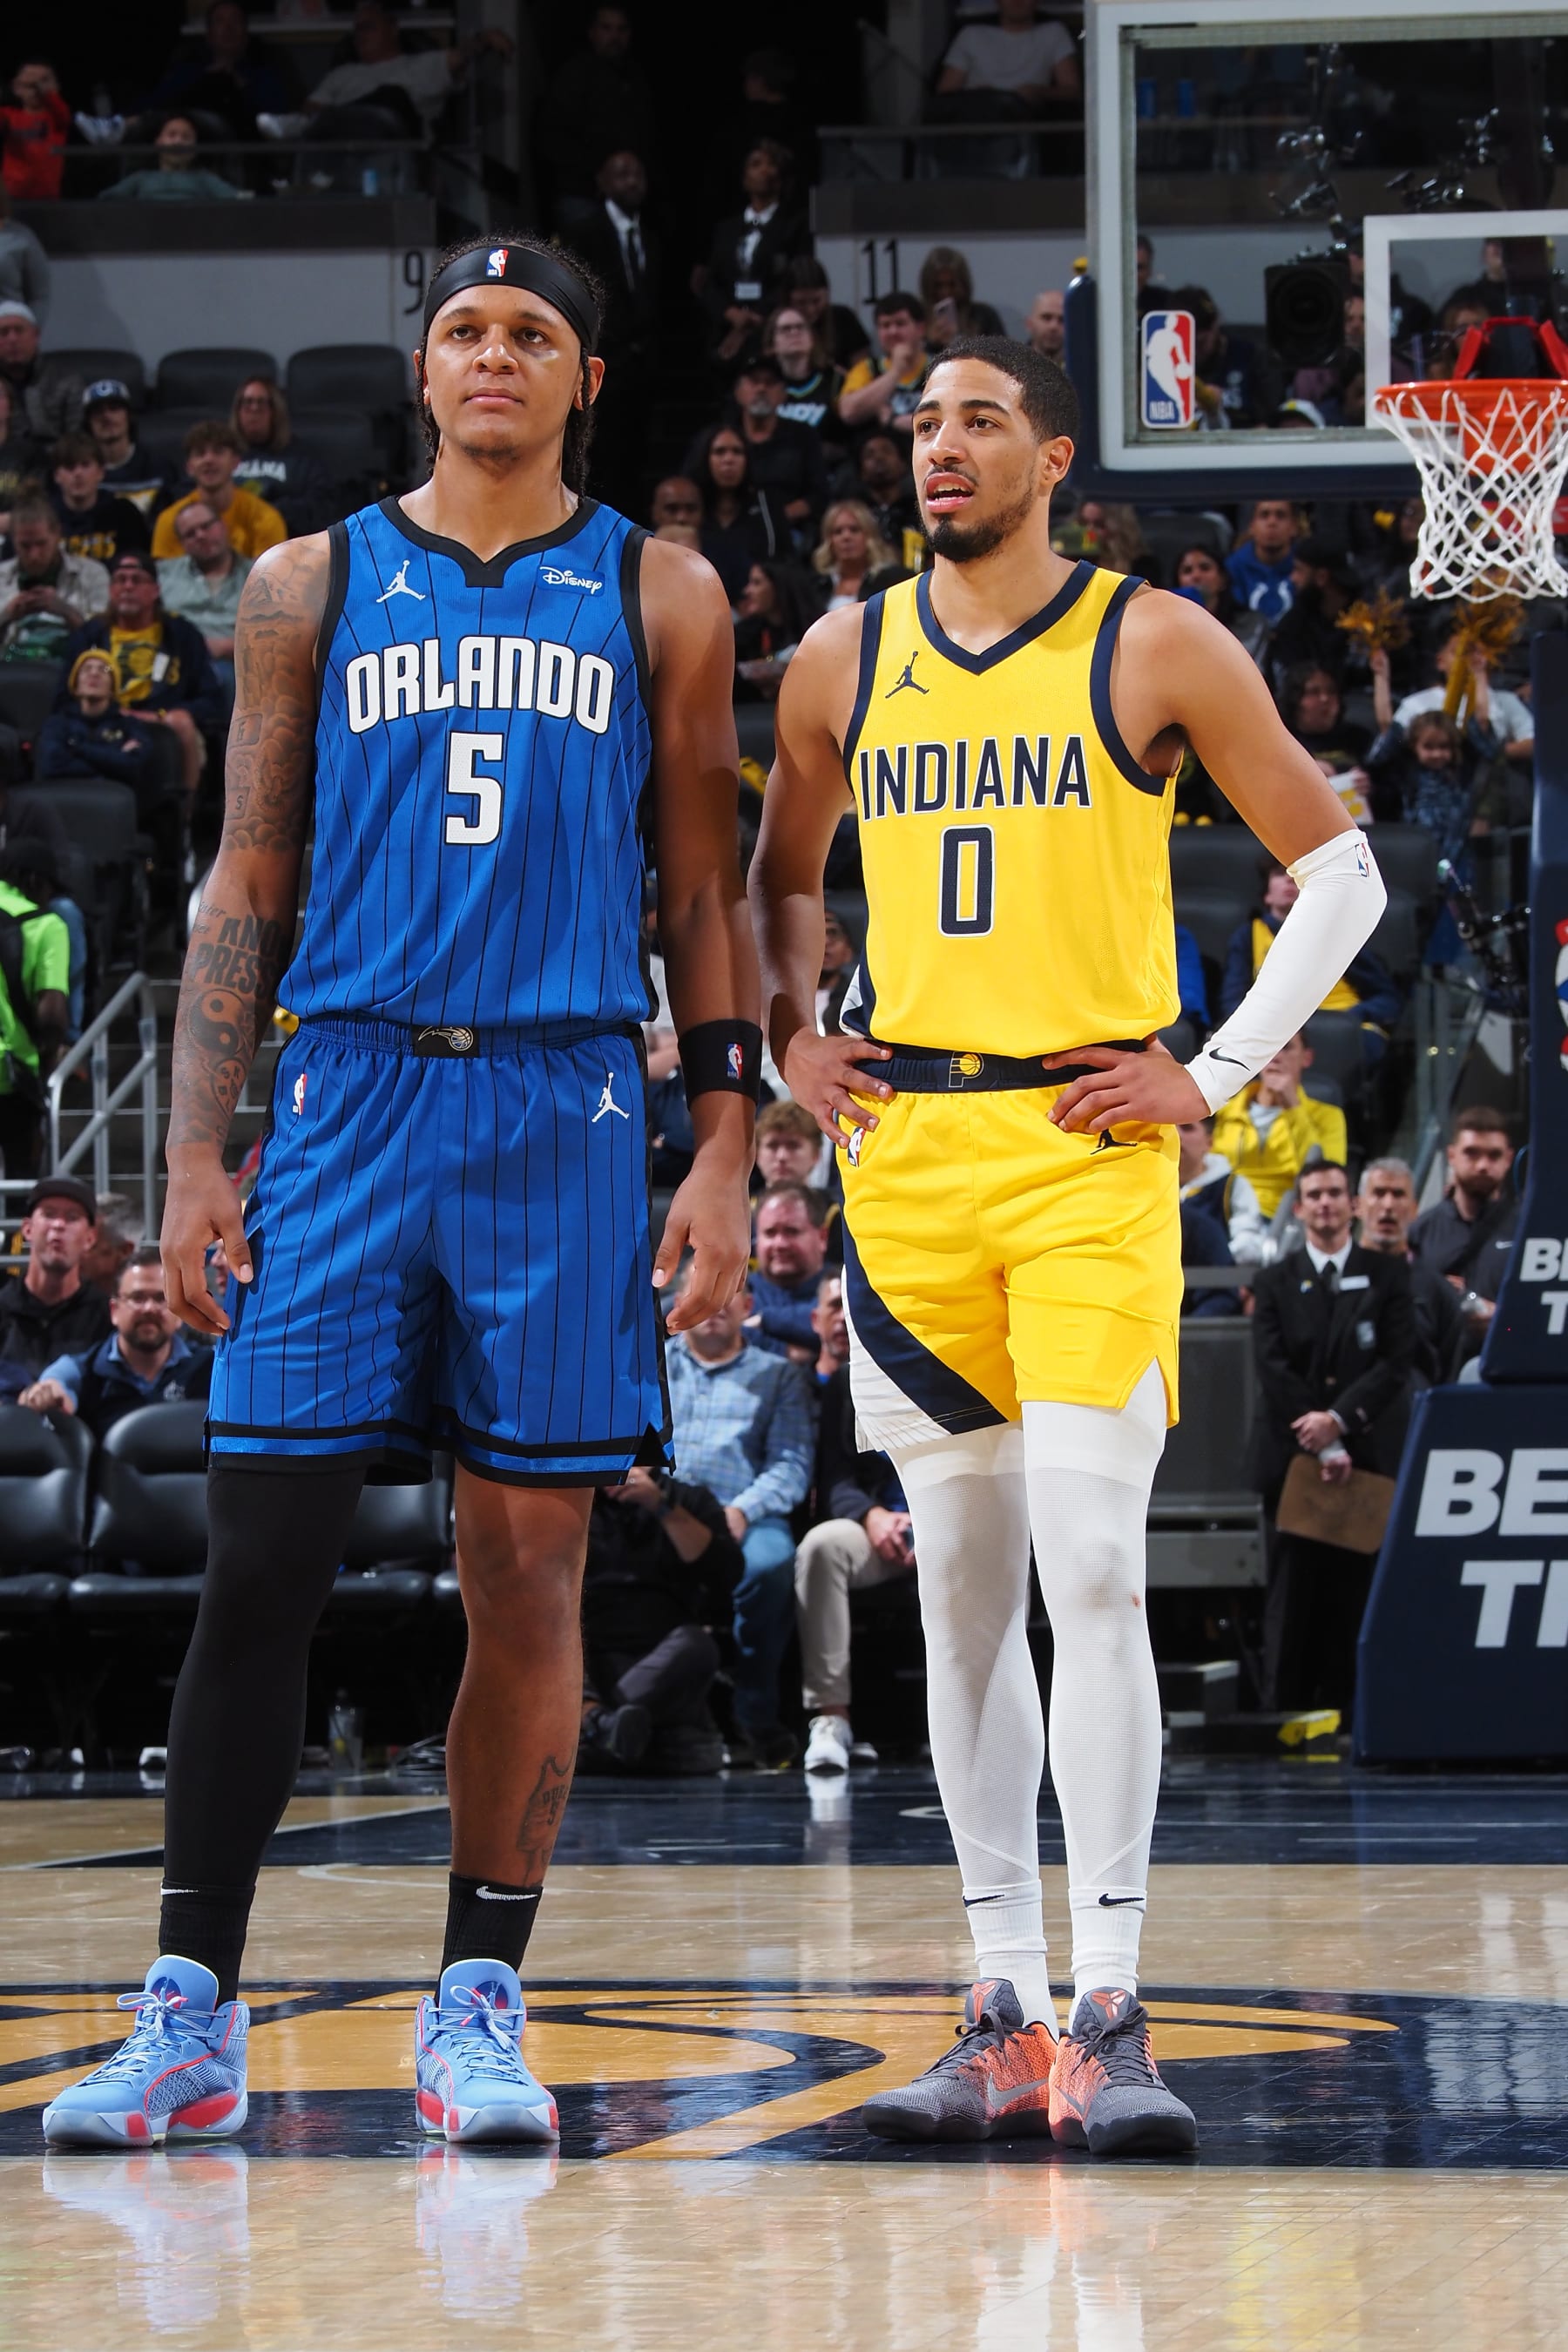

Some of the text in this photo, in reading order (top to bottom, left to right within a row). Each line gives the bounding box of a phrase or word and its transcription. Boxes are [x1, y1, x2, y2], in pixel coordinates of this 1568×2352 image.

[404, 251, 424, 314] 9
[861, 238, 901, 305] 11
[1149, 401, 1175, 420] NBA
[346, 635, 615, 735] ORLANDO
[445, 730, 504, 845] 5
[859, 734, 1092, 821] INDIANA
[937, 823, 995, 938] 0
[1519, 1237, 1568, 1281] B
[1414, 1448, 1568, 1538] BE
